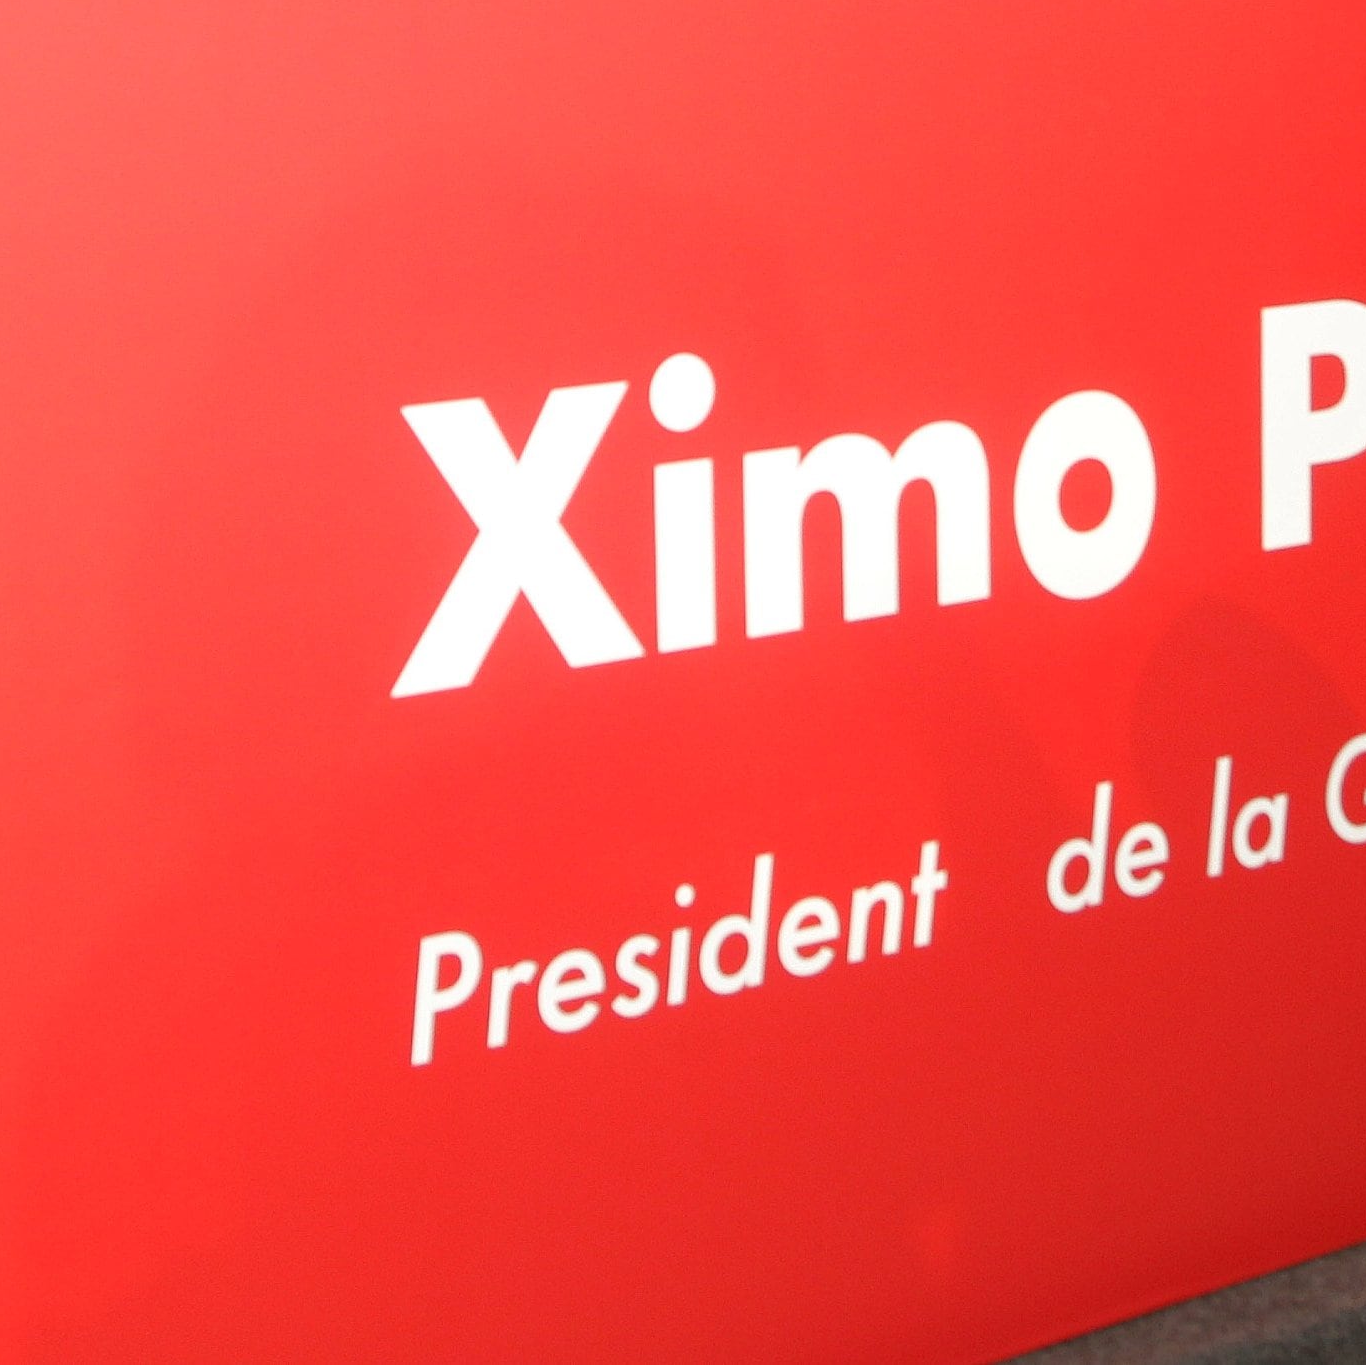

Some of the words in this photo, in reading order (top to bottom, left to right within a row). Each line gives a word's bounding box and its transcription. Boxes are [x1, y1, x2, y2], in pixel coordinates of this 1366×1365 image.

[390, 352, 1157, 699] Ximo
[410, 840, 949, 1067] President
[1046, 781, 1170, 914] de
[1206, 756, 1289, 878] la
